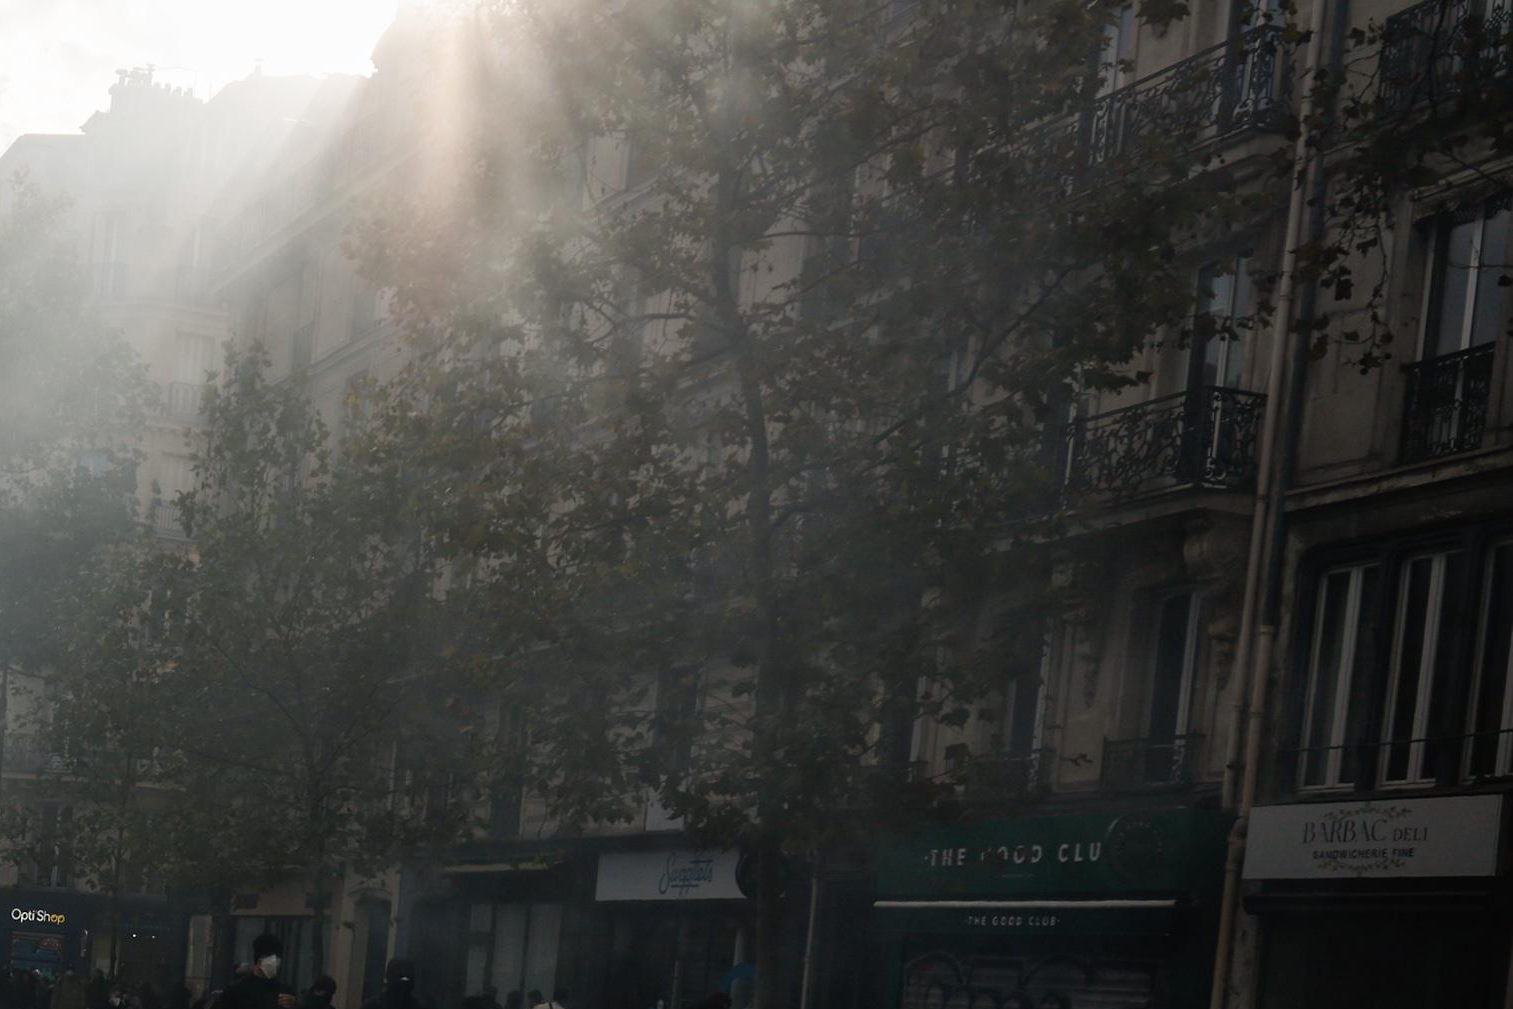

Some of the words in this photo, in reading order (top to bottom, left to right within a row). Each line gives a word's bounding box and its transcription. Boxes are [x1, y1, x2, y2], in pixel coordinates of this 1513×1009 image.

[1302, 818, 1388, 844] BARBAC
[1392, 826, 1429, 842] DELI
[930, 847, 967, 867] THE
[980, 844, 1043, 865] OOD
[1057, 841, 1103, 863] CLU
[1312, 848, 1388, 860] SANDWICHERIE
[1392, 847, 1415, 859] FINE
[967, 914, 987, 927] THE
[991, 914, 1023, 927] GOOD
[1028, 914, 1057, 927] CLUB
